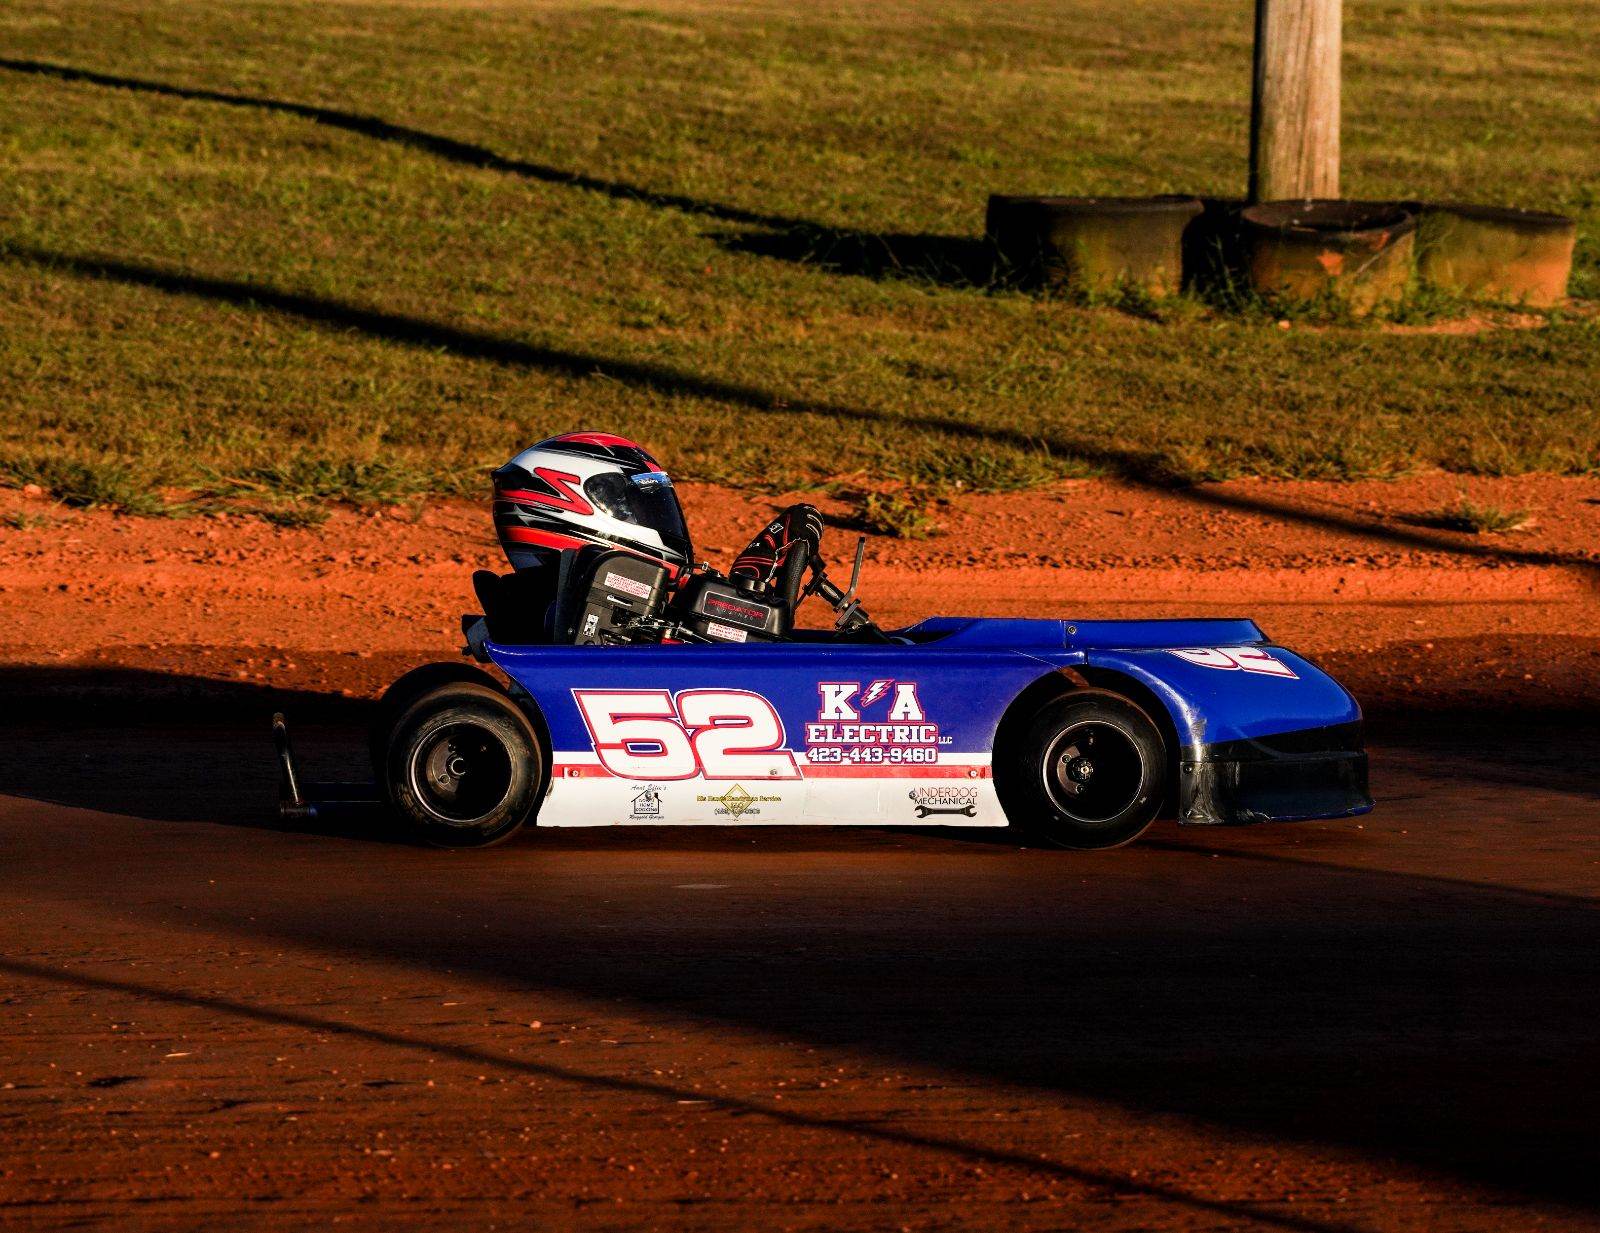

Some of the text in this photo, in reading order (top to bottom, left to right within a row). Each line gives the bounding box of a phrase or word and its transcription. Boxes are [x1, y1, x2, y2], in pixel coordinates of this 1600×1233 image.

[707, 598, 765, 618] PREDATOR
[570, 688, 804, 781] 52
[805, 723, 953, 745] ELECTRIC LLC
[806, 746, 938, 764] 423-443-9460
[914, 797, 978, 805] MECHANICAL
